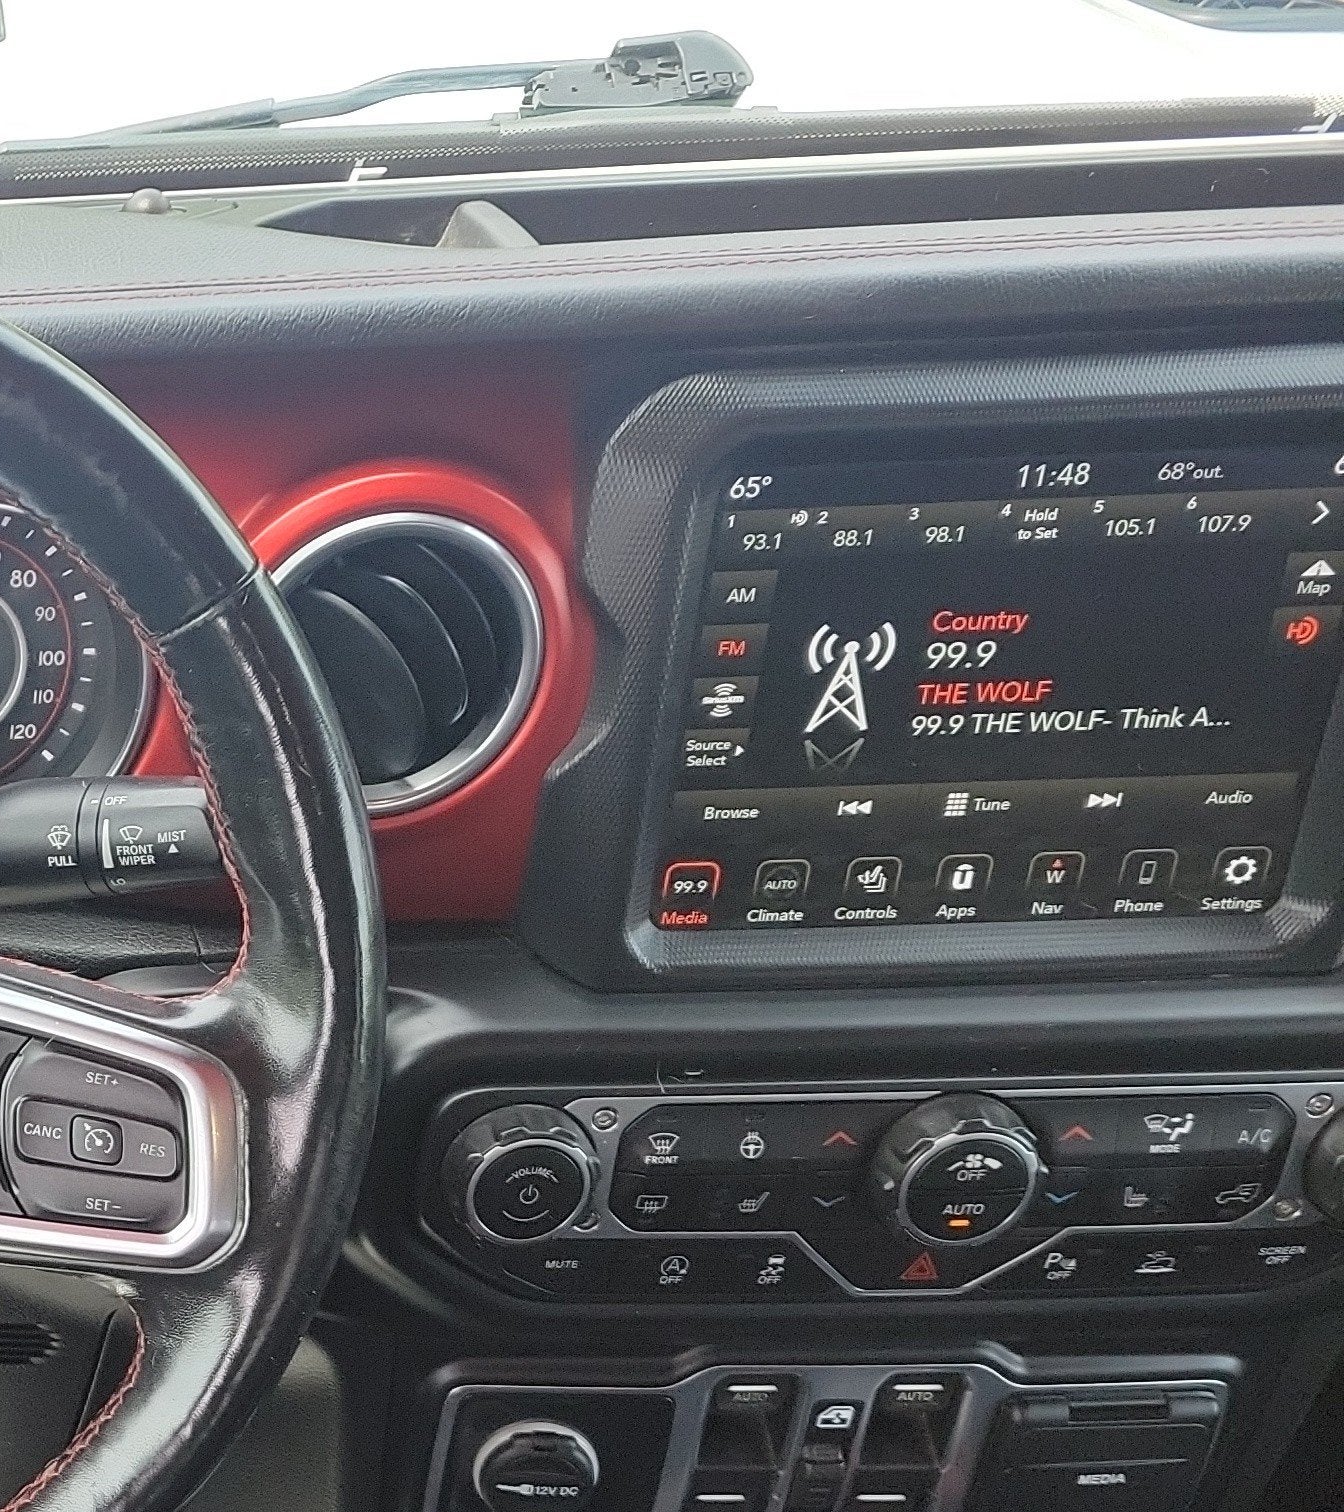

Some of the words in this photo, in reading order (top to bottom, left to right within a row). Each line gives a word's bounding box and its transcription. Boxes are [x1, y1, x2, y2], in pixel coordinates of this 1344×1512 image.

[729, 475, 773, 499] 65°
[1018, 462, 1091, 489] 11:48
[1093, 500, 1105, 513] 5
[1186, 496, 1198, 510] 6
[908, 507, 920, 521] 3
[1000, 503, 1012, 518] 4
[1024, 507, 1059, 523] Hold
[727, 514, 736, 529] 1
[817, 511, 829, 525] 2
[1198, 514, 1252, 534] 107.9
[925, 525, 965, 544] 98.1
[1017, 528, 1032, 540] to
[1035, 527, 1059, 540] Set
[1105, 518, 1156, 537] 105.1
[743, 533, 783, 551] 93.1
[833, 529, 874, 548] 88.1
[10, 569, 37, 588] 80
[726, 586, 757, 603] AM
[1296, 580, 1331, 597] Map
[35, 606, 56, 622] 90
[933, 610, 1029, 634] Country
[717, 641, 746, 657] FM
[926, 640, 997, 669] 99.9
[38, 650, 65, 667] 100
[33, 689, 54, 704] 110
[917, 683, 969, 704] THE
[977, 680, 1054, 703] WOLF
[912, 714, 964, 736] 99.9
[971, 712, 1024, 734] THE
[1120, 706, 1183, 729] Think
[9, 724, 36, 741] 120
[686, 740, 732, 752] Source
[686, 755, 728, 767] Select
[104, 796, 128, 805] OFF
[973, 798, 1011, 811] Tune
[1205, 790, 1253, 805] Audio
[704, 806, 760, 820] Browse
[157, 830, 187, 843] MIST
[116, 844, 154, 855] FRONT
[48, 855, 77, 868] PULL
[118, 855, 157, 866] WIPER
[1046, 870, 1066, 884] W
[673, 880, 709, 894] 99.9
[764, 879, 797, 891] AUTO
[936, 904, 976, 920] Apps
[1031, 902, 1064, 915] Nav
[1114, 899, 1164, 913] Phone
[1201, 897, 1262, 913] Settings
[662, 911, 708, 926] Media
[747, 909, 804, 923] Climate
[834, 905, 898, 920] Controls
[23, 1122, 62, 1140] CANC
[1237, 1128, 1273, 1144] A/C
[139, 1142, 166, 1158] RES
[1149, 1144, 1180, 1154] MODE
[645, 1155, 679, 1165] FRONT
[511, 1166, 553, 1179] VOLUME
[956, 1168, 987, 1182] OFF
[942, 1203, 985, 1216] AUTO
[545, 1259, 579, 1270] MUTE
[659, 1274, 683, 1285] OFF
[757, 1274, 781, 1285] OFF
[1046, 1270, 1072, 1281] OFF
[1077, 1473, 1126, 1485] MEDIA
[535, 1485, 558, 1497] 12V
[559, 1485, 579, 1497] DC
